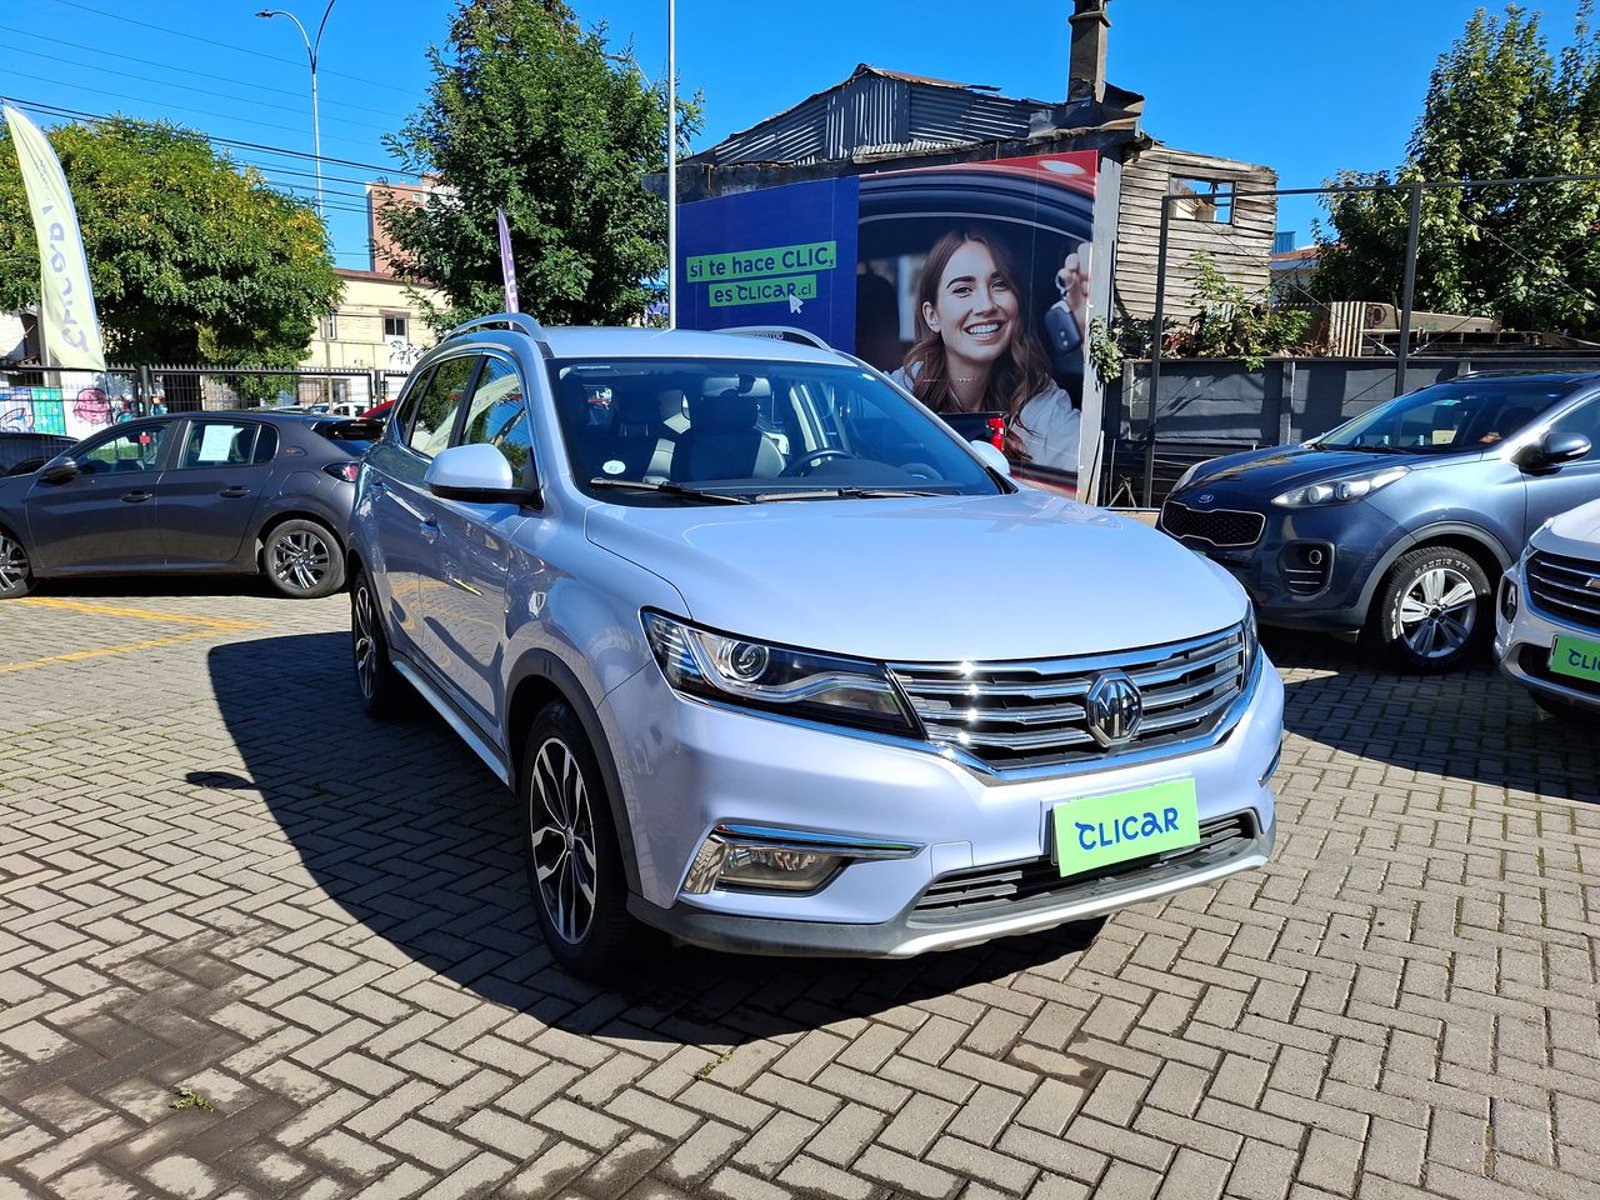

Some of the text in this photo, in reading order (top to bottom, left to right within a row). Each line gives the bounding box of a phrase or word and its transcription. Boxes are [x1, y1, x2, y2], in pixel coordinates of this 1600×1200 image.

[690, 246, 834, 278] si te hace CLIC,
[714, 288, 733, 303] es
[1568, 648, 1600, 671] CLI
